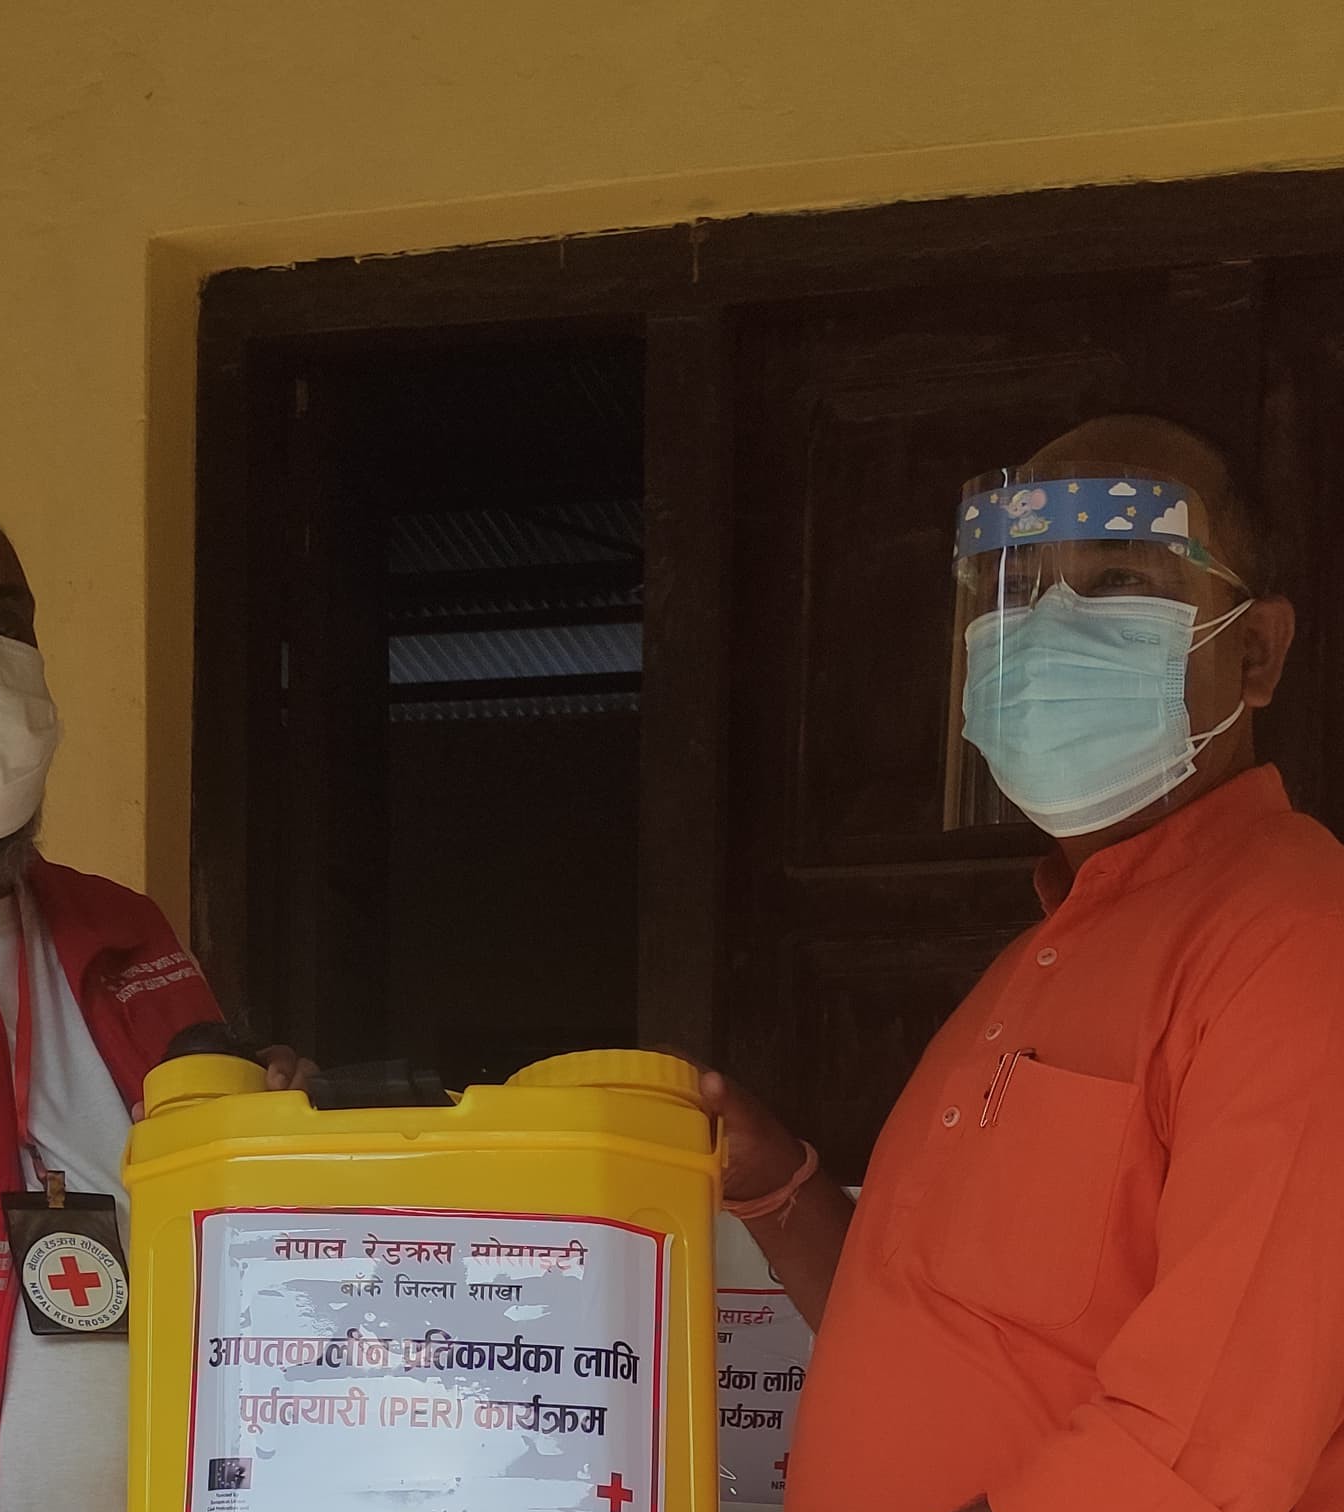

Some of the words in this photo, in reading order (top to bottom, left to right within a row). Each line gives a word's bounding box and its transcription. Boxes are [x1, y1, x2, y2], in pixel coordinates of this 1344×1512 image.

[274, 1232, 347, 1261] नेपाल
[362, 1233, 456, 1265] रेडक्रस
[29, 1281, 53, 1312] NEPAL
[53, 1311, 75, 1325] RED
[77, 1313, 111, 1328] CROSS
[109, 1277, 124, 1316] SOCIETY
[394, 1273, 457, 1300] जिल्ला
[467, 1283, 523, 1302] शाखा
[573, 1341, 641, 1384] लागि
[378, 1396, 464, 1430] (PER)
[474, 1394, 608, 1437] कार्यक्रम
